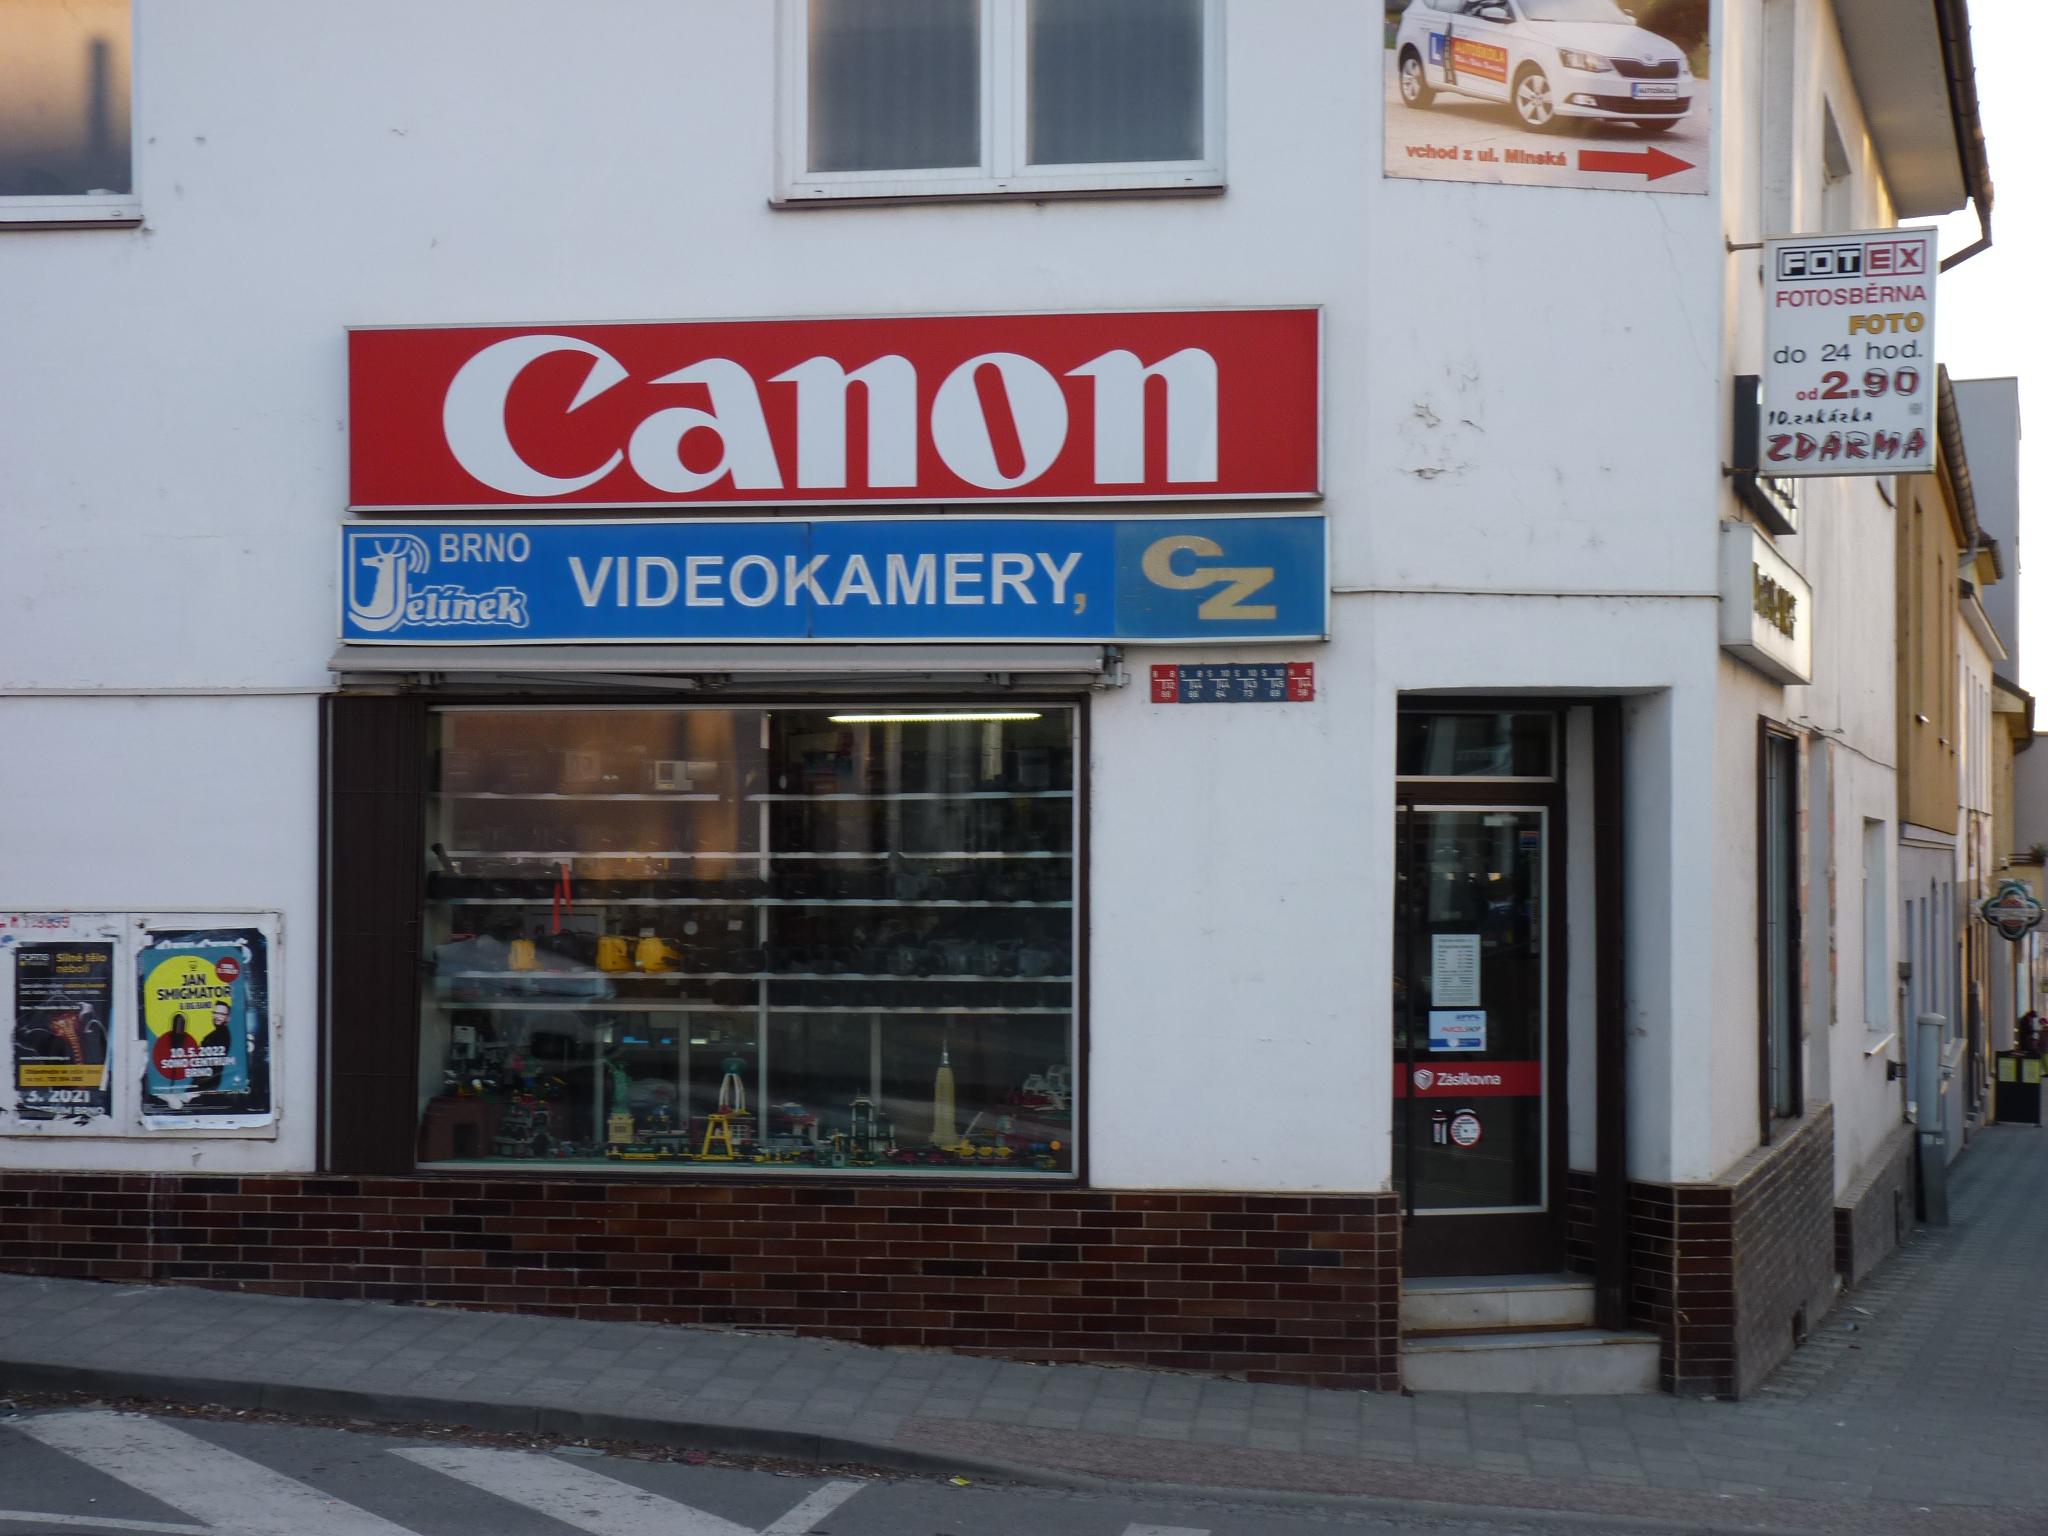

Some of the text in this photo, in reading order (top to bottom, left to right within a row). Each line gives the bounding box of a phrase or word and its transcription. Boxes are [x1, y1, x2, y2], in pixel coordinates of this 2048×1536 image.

[1406, 145, 1457, 160] vchod
[1463, 151, 1472, 161] z
[1478, 149, 1499, 162] ul.
[1779, 243, 1922, 279] FOTEX
[1776, 283, 1926, 307] FOTOSBĚRNA
[1848, 311, 1925, 335] FOTO
[1773, 340, 1923, 364] do 24 hod.
[1796, 366, 1920, 401] od 2.90
[443, 334, 1219, 497] Canon
[1767, 427, 1928, 462] ZDARMA
[440, 532, 531, 563] BRNO
[1141, 535, 1277, 621] CZ
[182, 974, 206, 986] JAN
[157, 986, 232, 1000] SMIGMATOR
[1437, 1072, 1502, 1087] Zásilkovna
[48, 1090, 91, 1103] 2021
